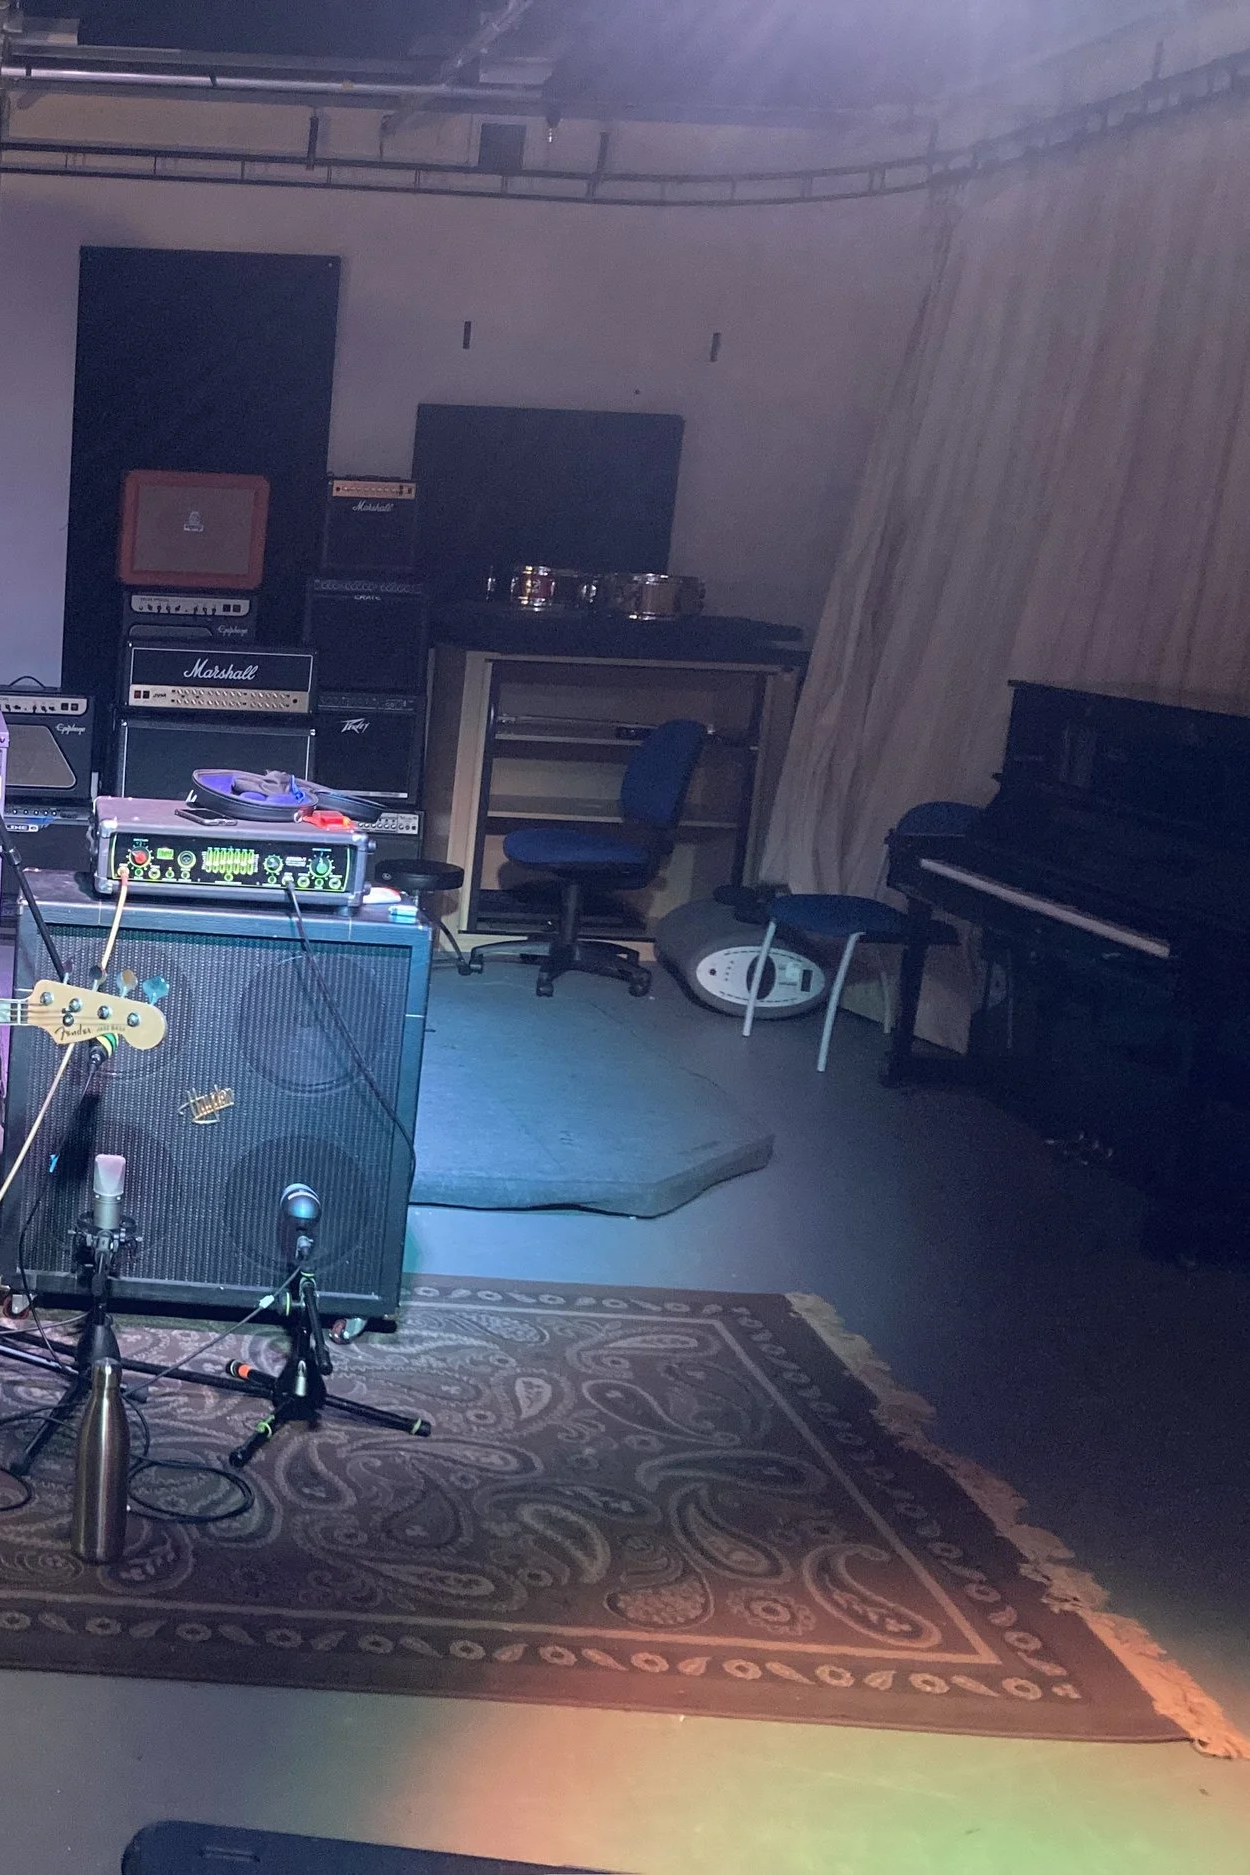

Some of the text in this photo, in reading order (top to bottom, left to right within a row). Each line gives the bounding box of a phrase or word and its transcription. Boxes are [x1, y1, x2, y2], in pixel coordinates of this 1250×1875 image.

[352, 500, 394, 512] Marshall
[183, 658, 258, 681] Marshall
[55, 723, 86, 735] Epiphone
[54, 1024, 91, 1041] Fender
